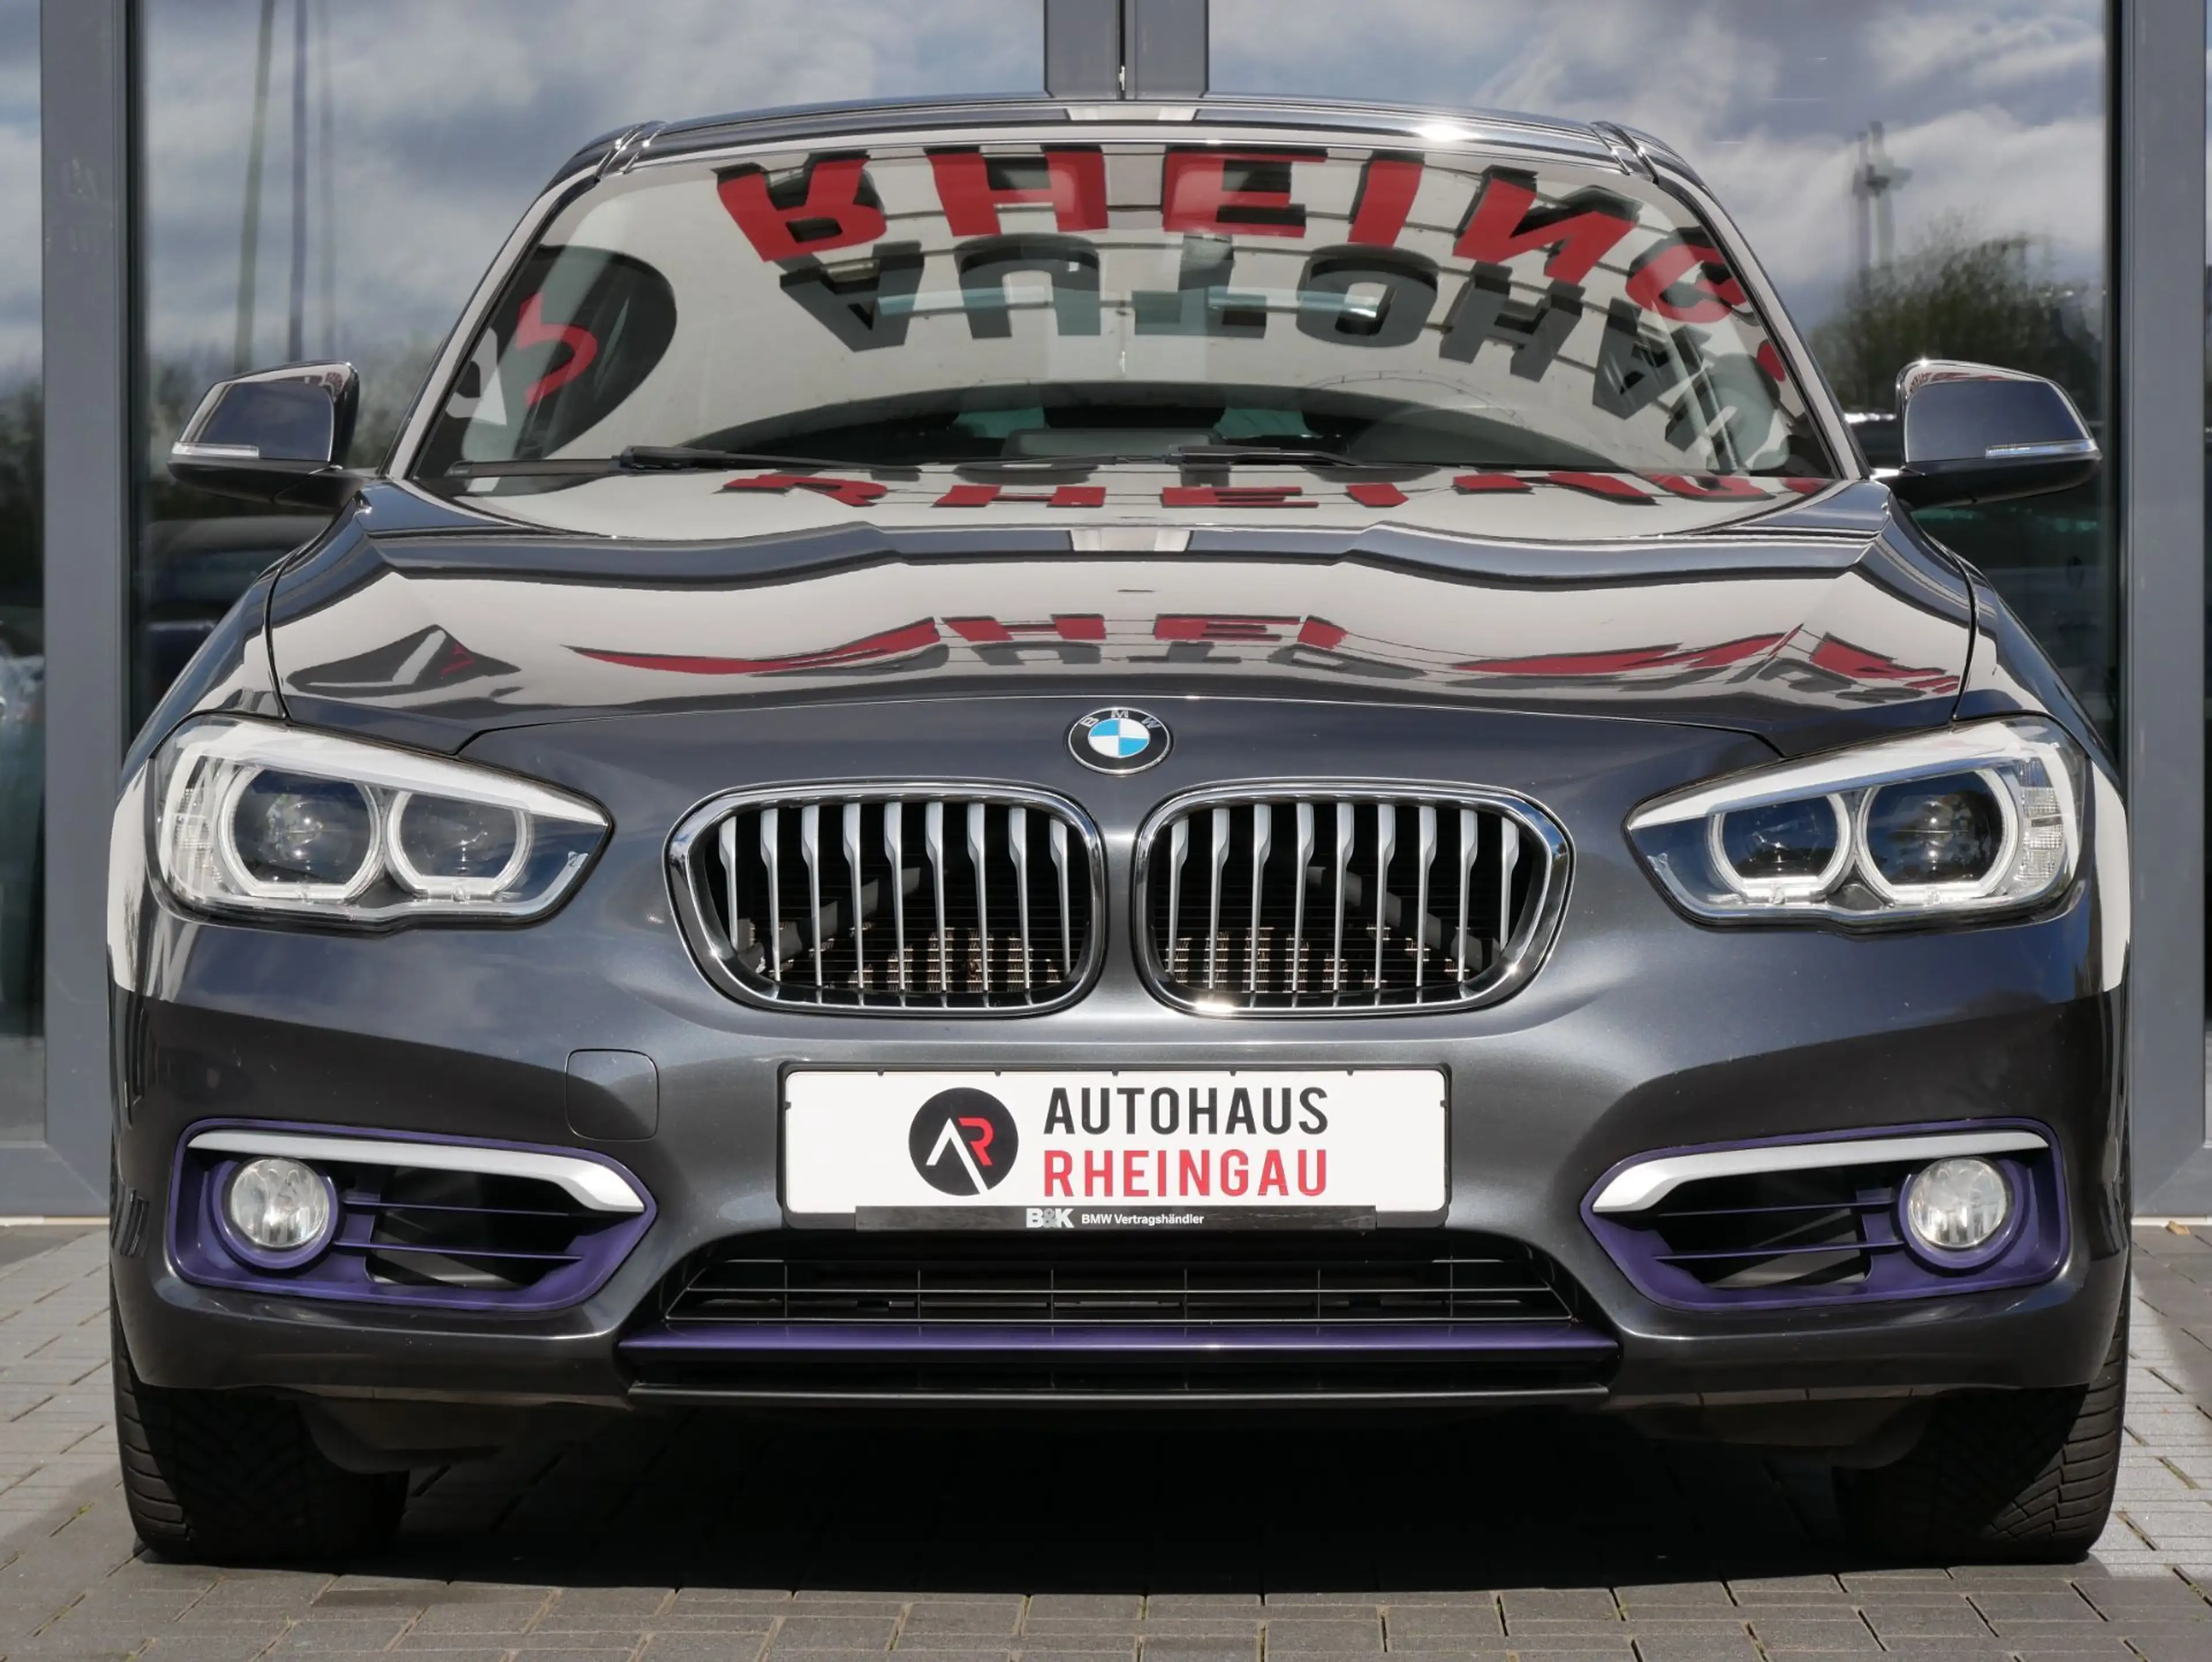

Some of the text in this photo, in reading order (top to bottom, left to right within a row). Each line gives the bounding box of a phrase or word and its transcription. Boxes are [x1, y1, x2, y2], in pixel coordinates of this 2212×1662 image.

[1044, 1087, 1328, 1135] AUTOHAUS
[1044, 1149, 1327, 1197] RHEINGAU
[1026, 1208, 1205, 1228] B&K BMW Vertragshändler
